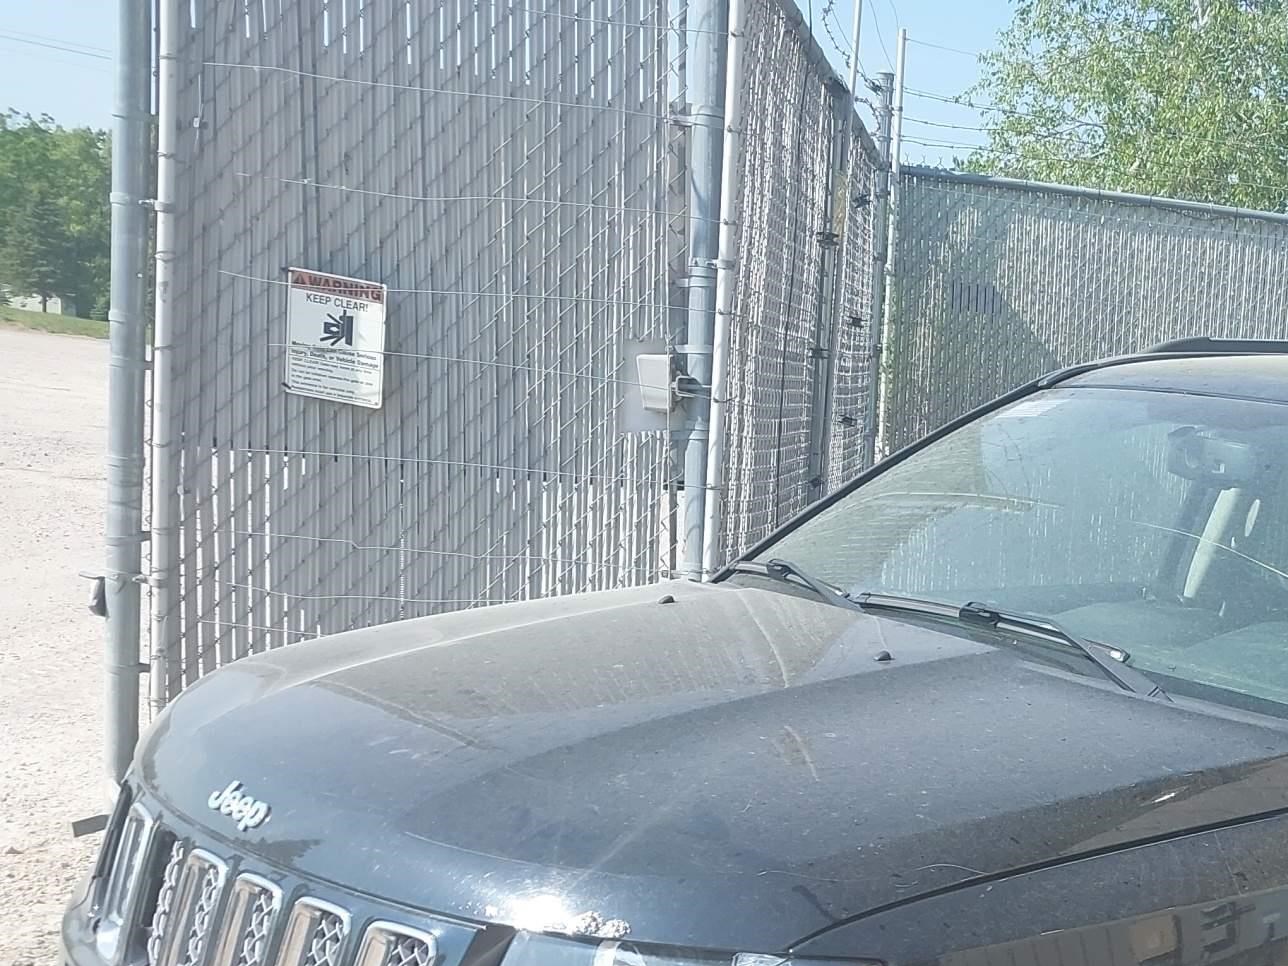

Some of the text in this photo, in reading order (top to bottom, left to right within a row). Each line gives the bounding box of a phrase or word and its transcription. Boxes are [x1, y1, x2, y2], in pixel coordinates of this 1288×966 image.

[308, 275, 382, 301] WARNING
[306, 293, 368, 312] KEEP CLEAR!
[208, 780, 269, 831] Jeep
